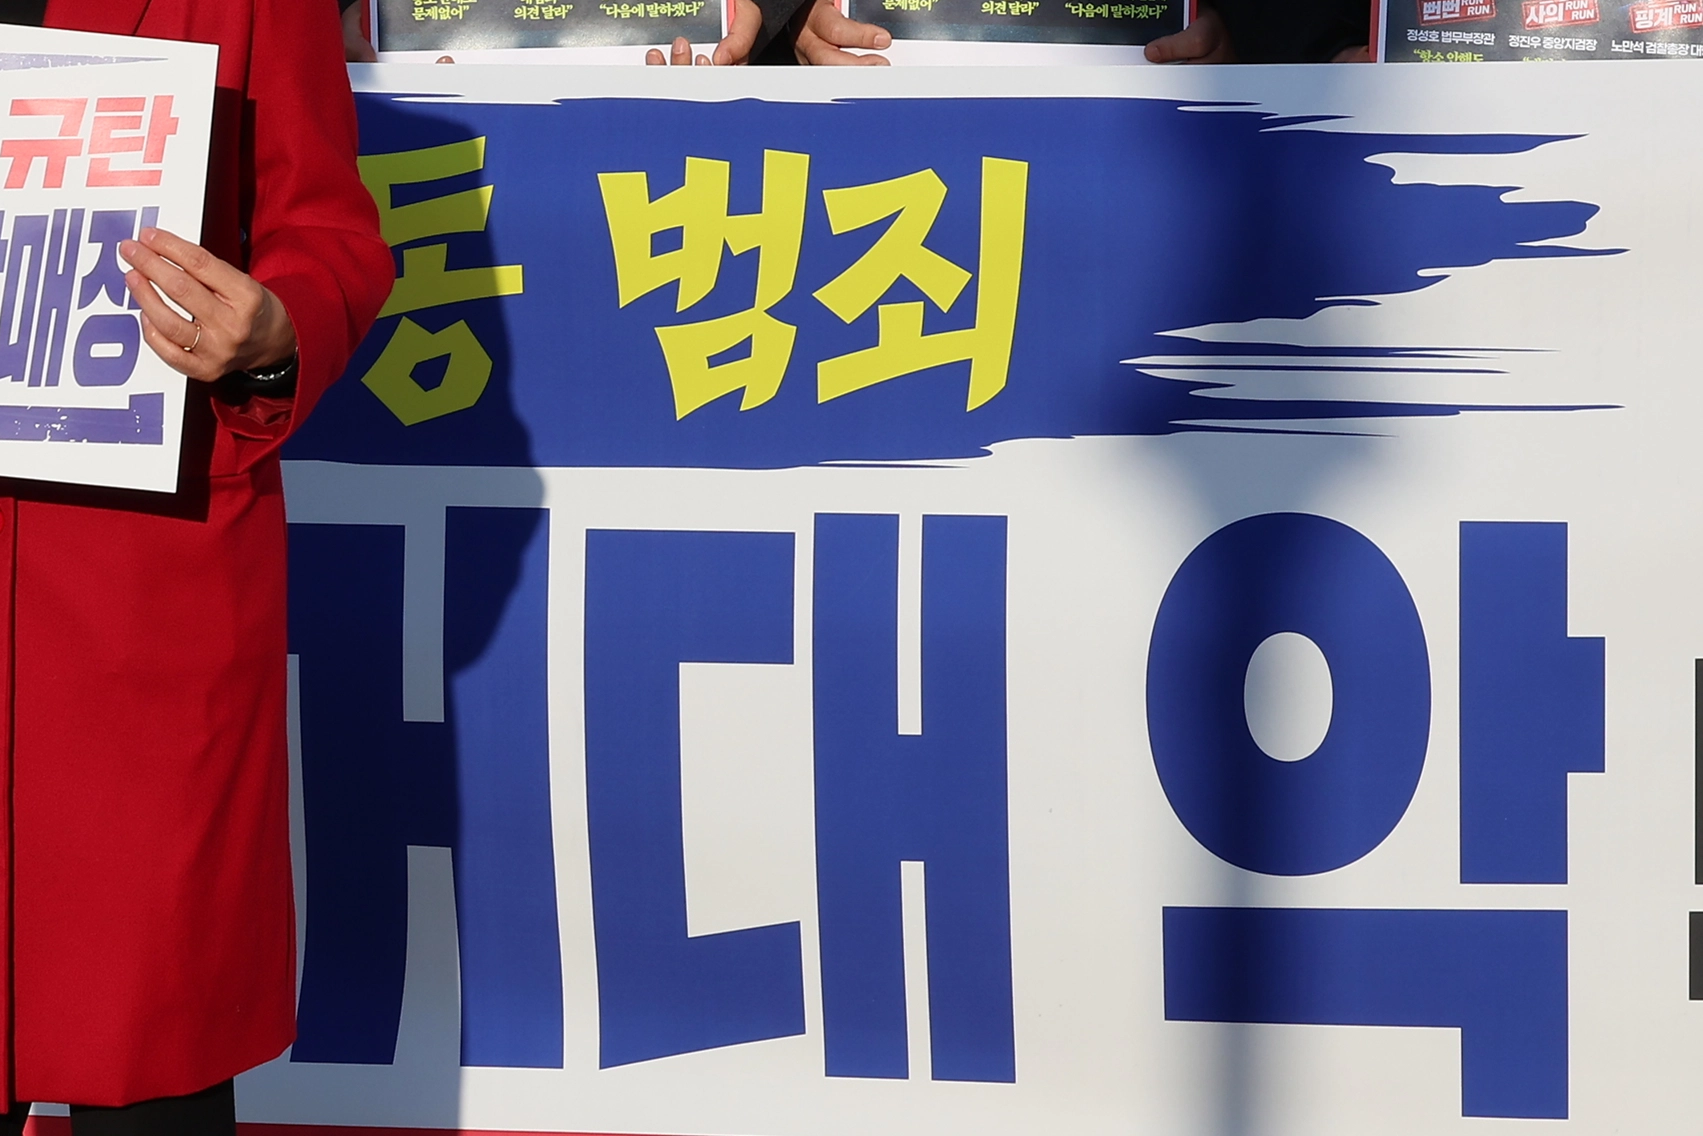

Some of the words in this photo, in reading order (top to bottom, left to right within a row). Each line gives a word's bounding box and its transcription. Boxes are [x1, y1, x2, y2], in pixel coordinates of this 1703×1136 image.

[0, 95, 179, 190] 규탄
[596, 148, 1029, 422] 범죄
[1146, 511, 1607, 1121] 악
